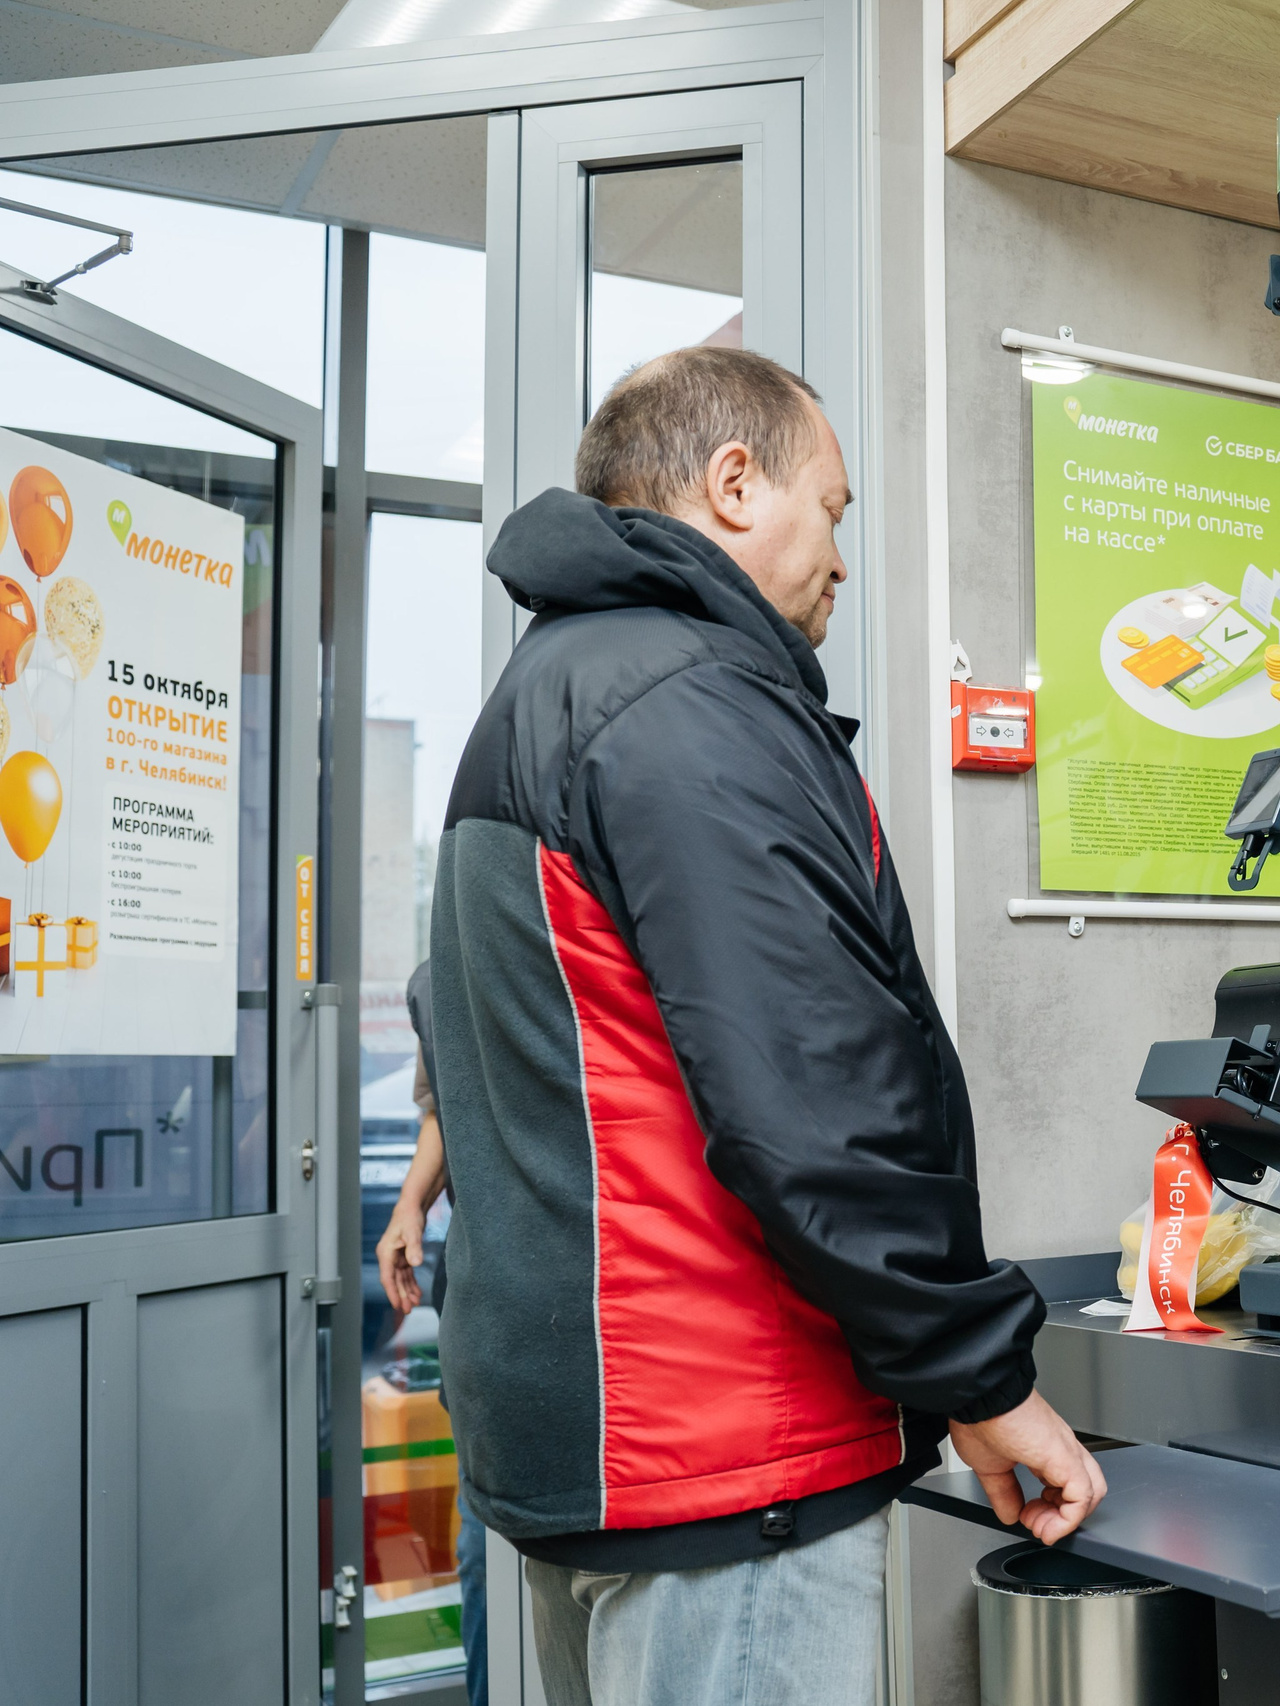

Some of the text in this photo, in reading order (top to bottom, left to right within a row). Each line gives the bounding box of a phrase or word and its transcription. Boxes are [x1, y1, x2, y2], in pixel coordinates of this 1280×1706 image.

[1226, 441, 1264, 461] СБЕР
[1063, 459, 1271, 514] Снимайте наличные
[1063, 494, 1264, 541] с карты при оплате
[1064, 525, 1089, 544] на
[107, 660, 228, 710] 15 октября
[107, 695, 228, 743] ОТКРЫТИЕ
[107, 727, 227, 766] 100-го магазина
[106, 756, 227, 791] в г. Челябинск!
[113, 796, 195, 822] ПРОГРАММА
[112, 817, 215, 845] МЕРОПРИЯТИЙ:
[118, 841, 142, 852] 10:00
[118, 870, 142, 880] 10:00
[300, 908, 310, 974] СЕБЯ
[1159, 1169, 1192, 1315] Челябинск
